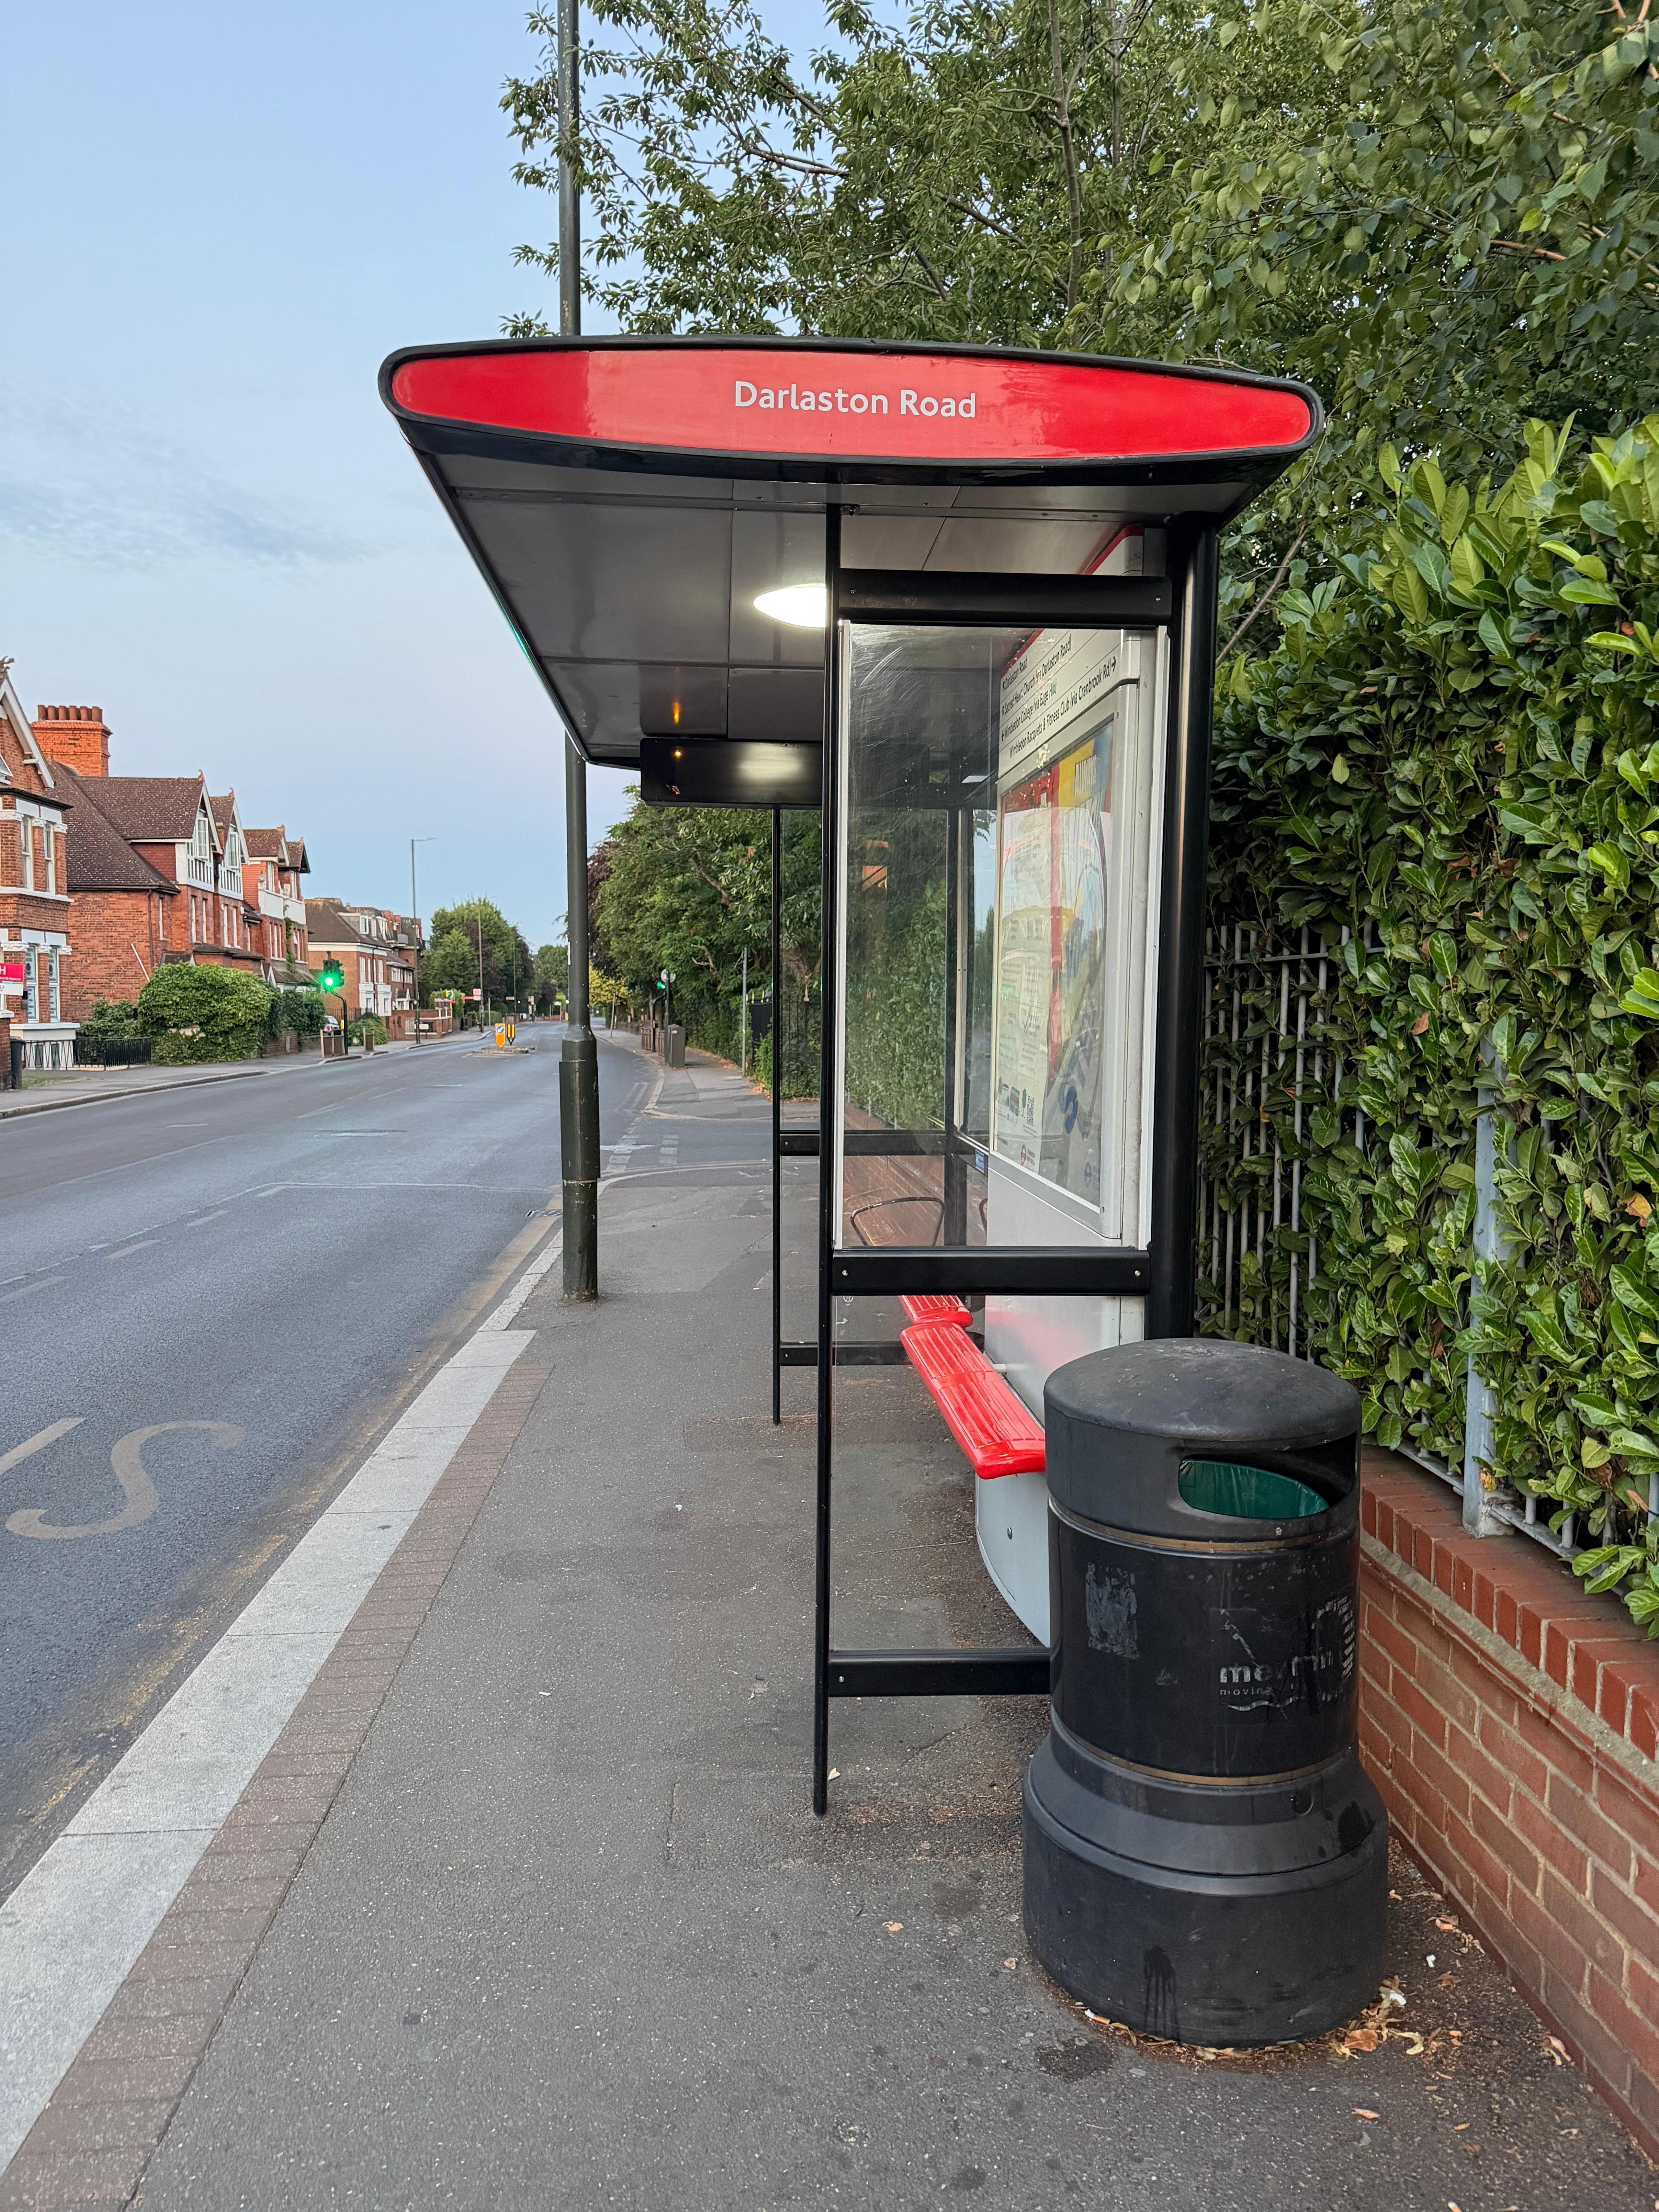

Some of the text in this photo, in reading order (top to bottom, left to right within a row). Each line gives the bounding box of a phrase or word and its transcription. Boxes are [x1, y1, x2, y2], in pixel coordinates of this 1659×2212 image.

[735, 381, 975, 418] Darlaston Road
[1024, 675, 1035, 695] Church
[1042, 652, 1059, 678] Darlaston
[1060, 634, 1071, 658] Road)
[1027, 723, 1042, 744] Racquets
[1043, 718, 1046, 731] &
[1046, 709, 1059, 728] Fitness
[1060, 697, 1069, 716] Club
[1079, 669, 1102, 700] Cranbrook
